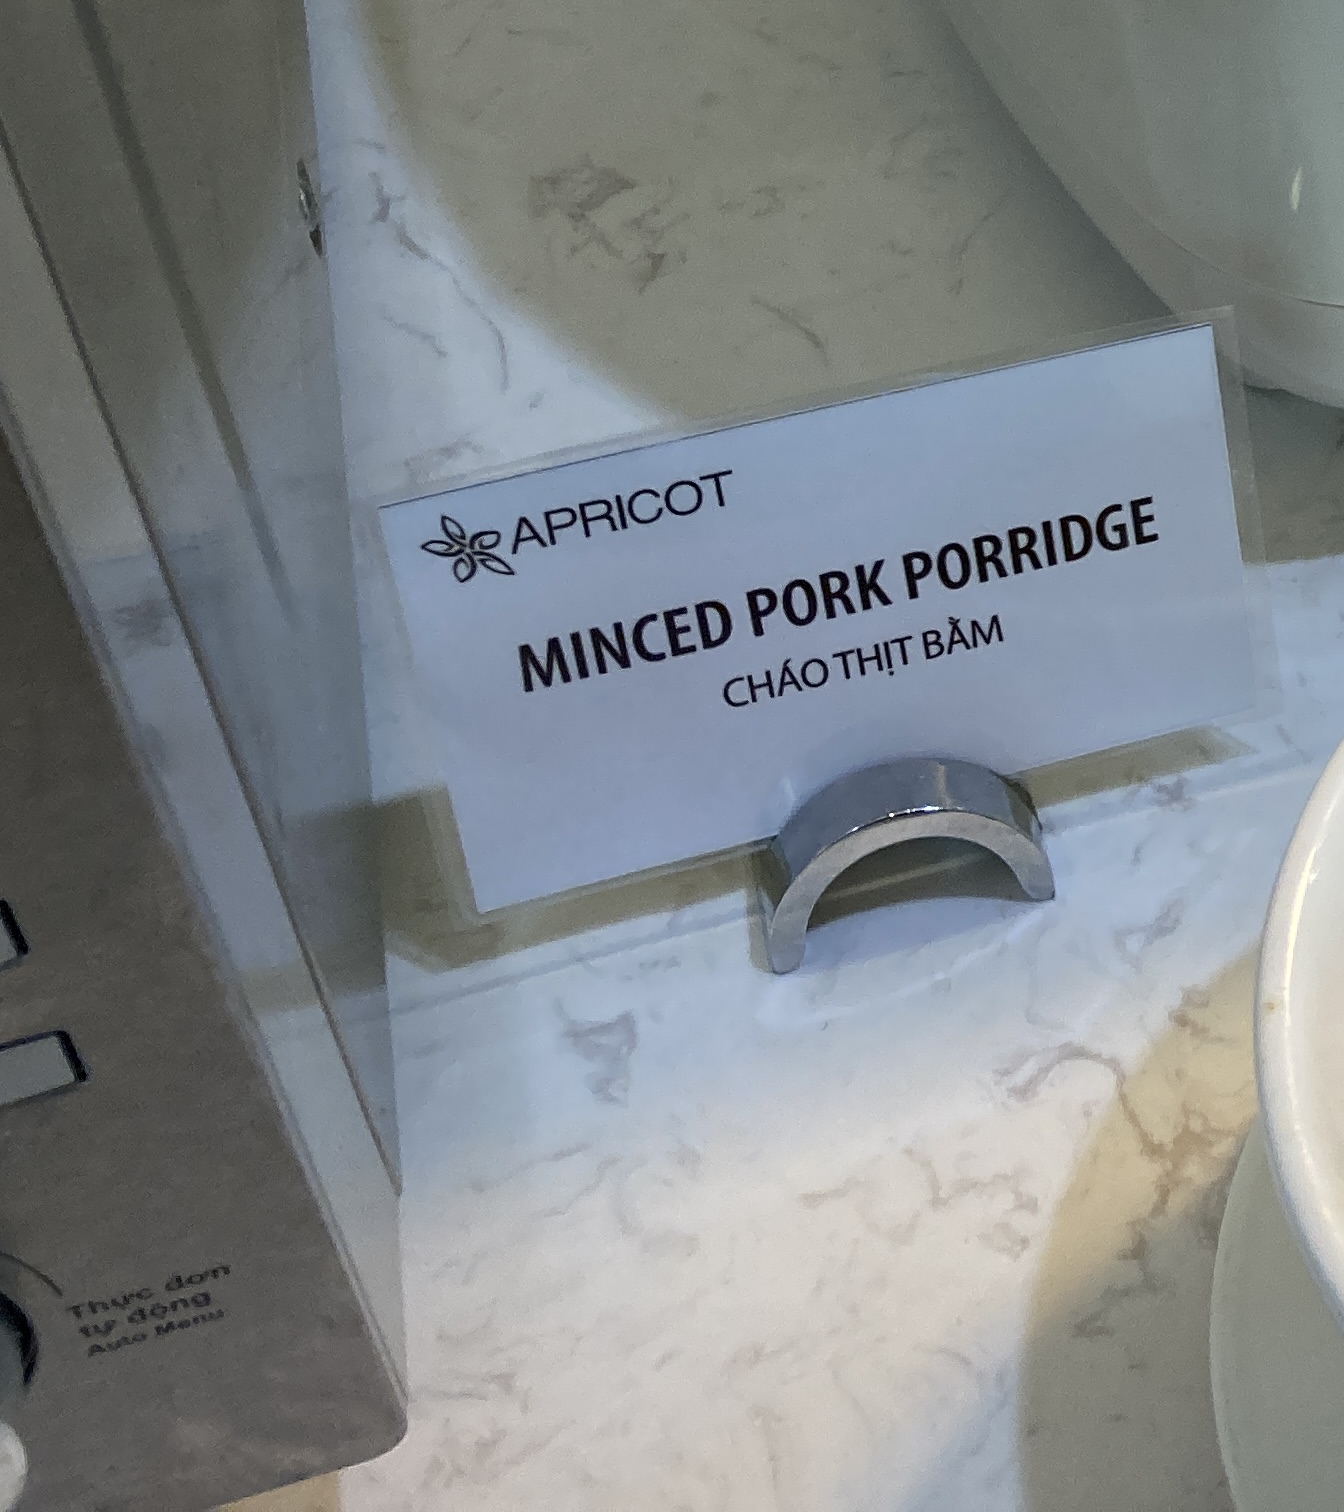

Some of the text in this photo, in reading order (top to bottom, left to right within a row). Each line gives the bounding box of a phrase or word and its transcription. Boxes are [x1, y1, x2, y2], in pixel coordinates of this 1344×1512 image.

[510, 470, 734, 556] APRICOT
[517, 496, 1161, 694] MINCED PORK PORRIDGE
[722, 656, 831, 709] CHÁO
[832, 634, 913, 680] THỊT
